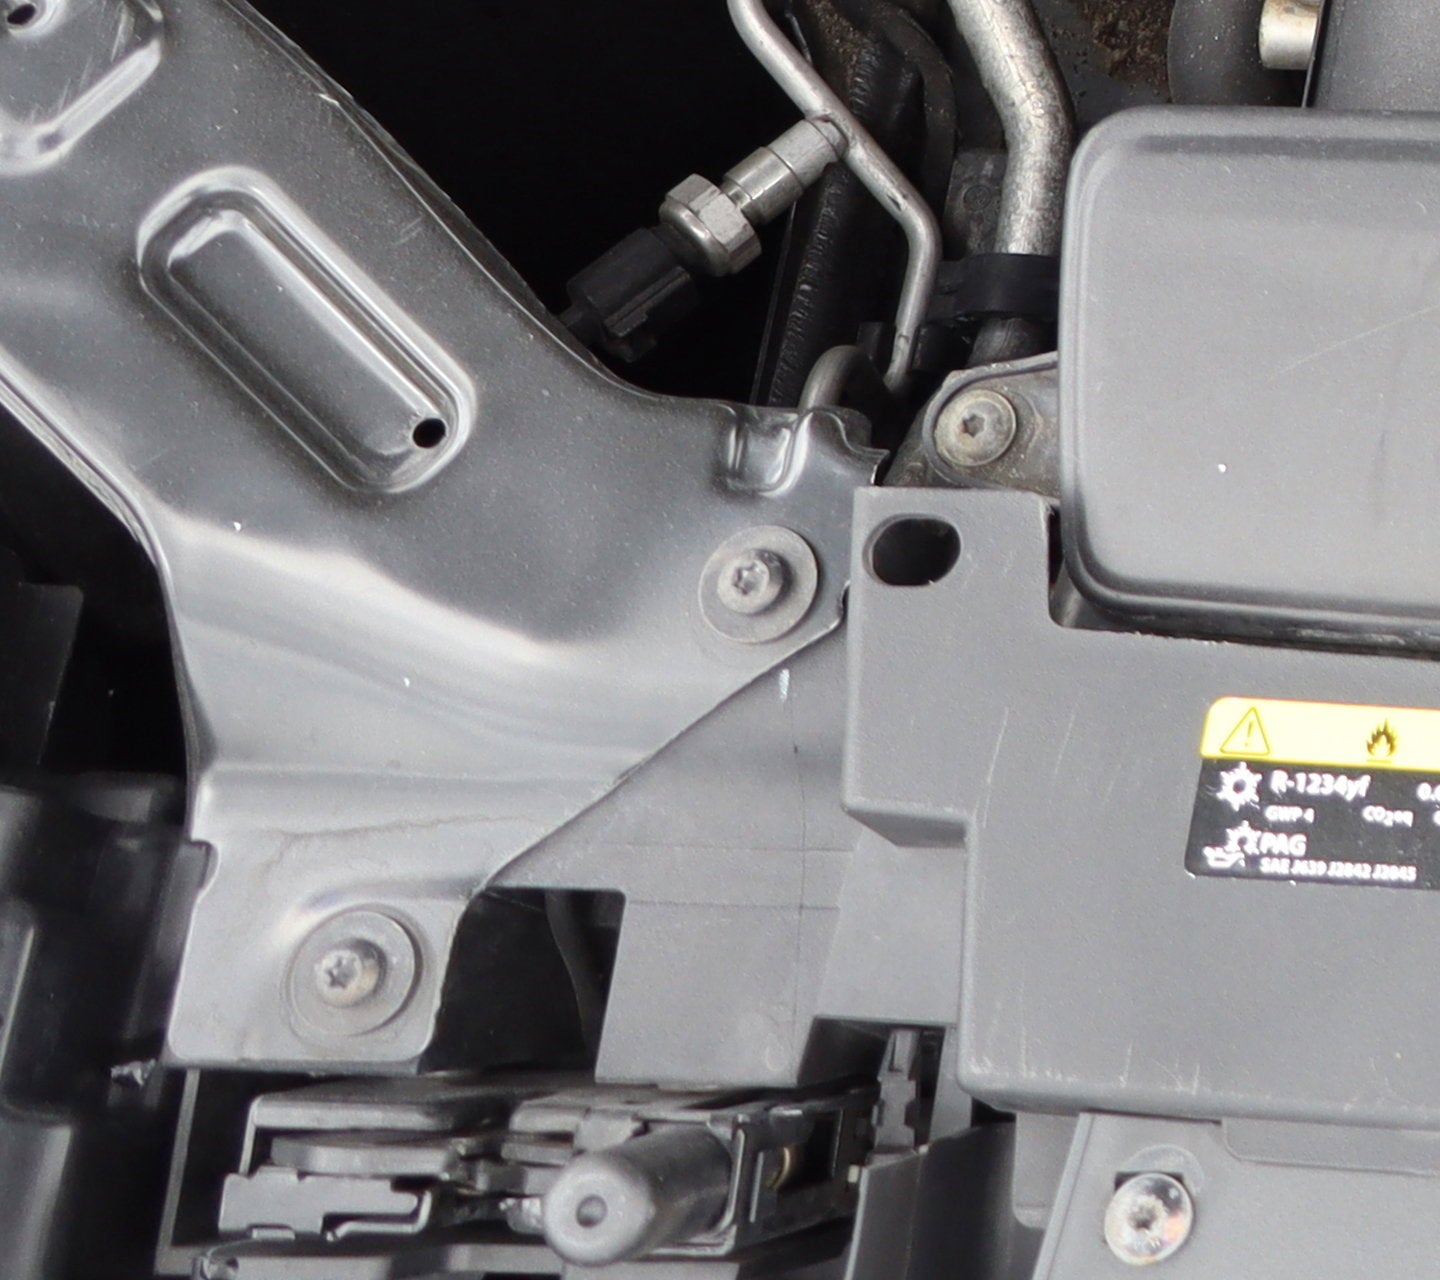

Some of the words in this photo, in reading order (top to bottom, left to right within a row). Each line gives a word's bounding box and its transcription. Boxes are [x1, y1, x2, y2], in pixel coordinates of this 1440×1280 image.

[1270, 770, 1370, 801] R-1234yf
[1265, 807, 1302, 822] GWP
[1260, 833, 1307, 856] PAG
[1260, 858, 1289, 874] SAE
[1328, 862, 1371, 879] J2842
